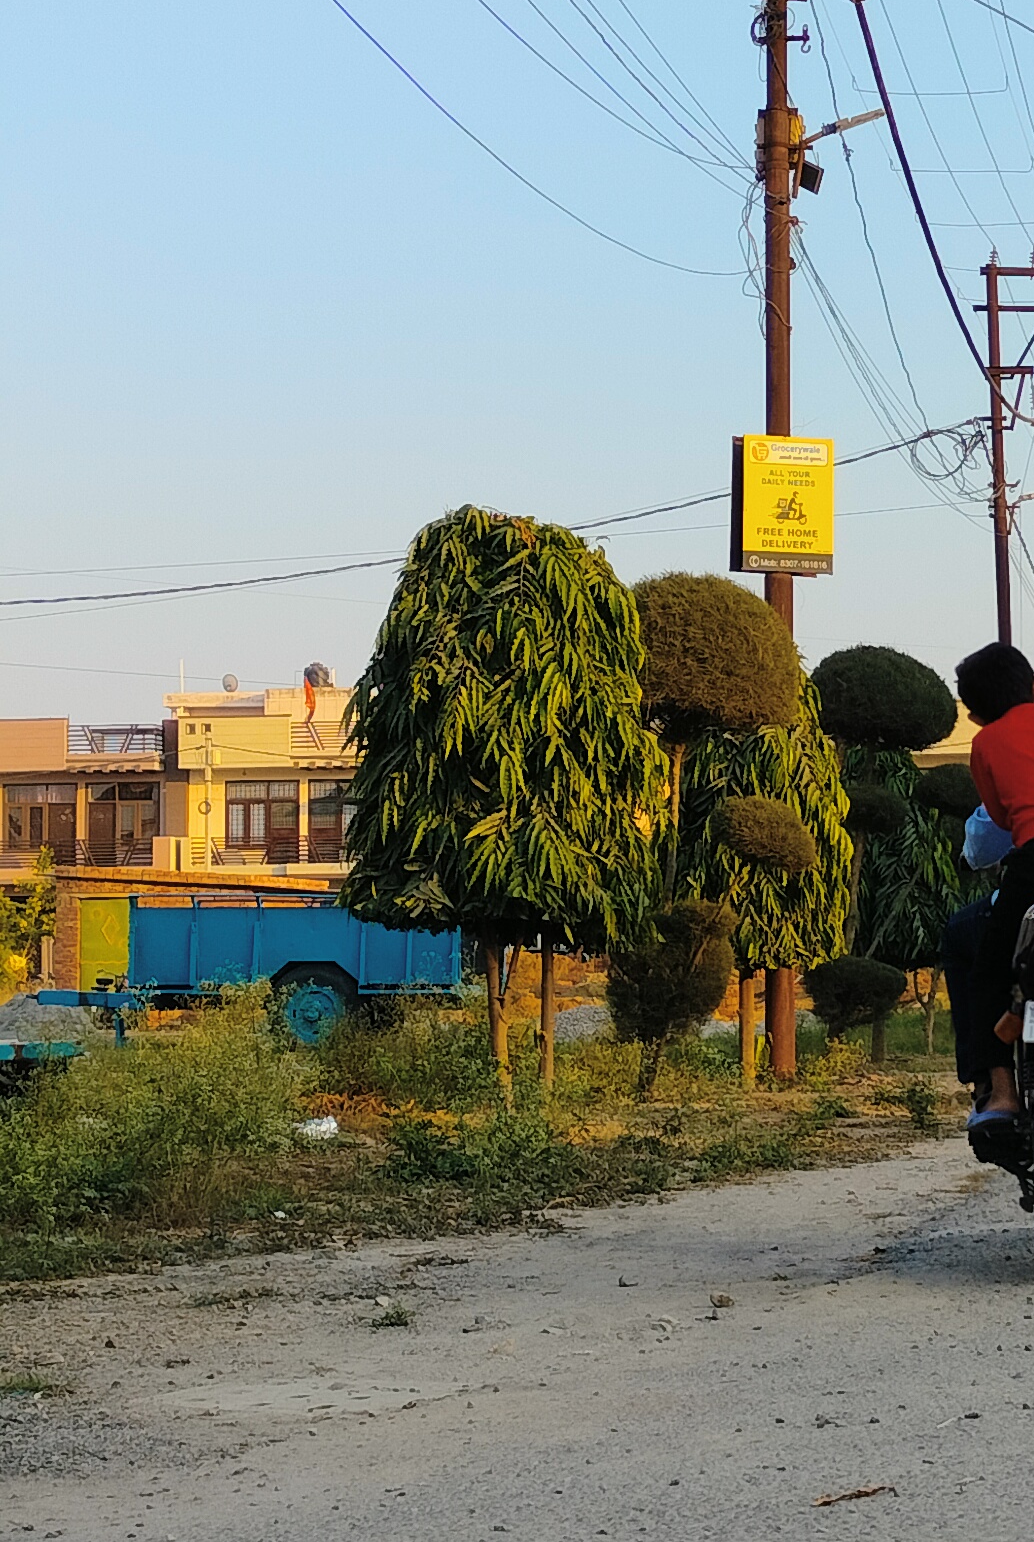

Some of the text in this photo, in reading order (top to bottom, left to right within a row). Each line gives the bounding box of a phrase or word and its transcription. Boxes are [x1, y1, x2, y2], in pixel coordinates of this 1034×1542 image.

[769, 469, 811, 478] ALL YOUR
[761, 478, 815, 487] DAILY NEEDS
[757, 527, 818, 538] FREE HOME
[762, 539, 814, 549] DELIVERY
